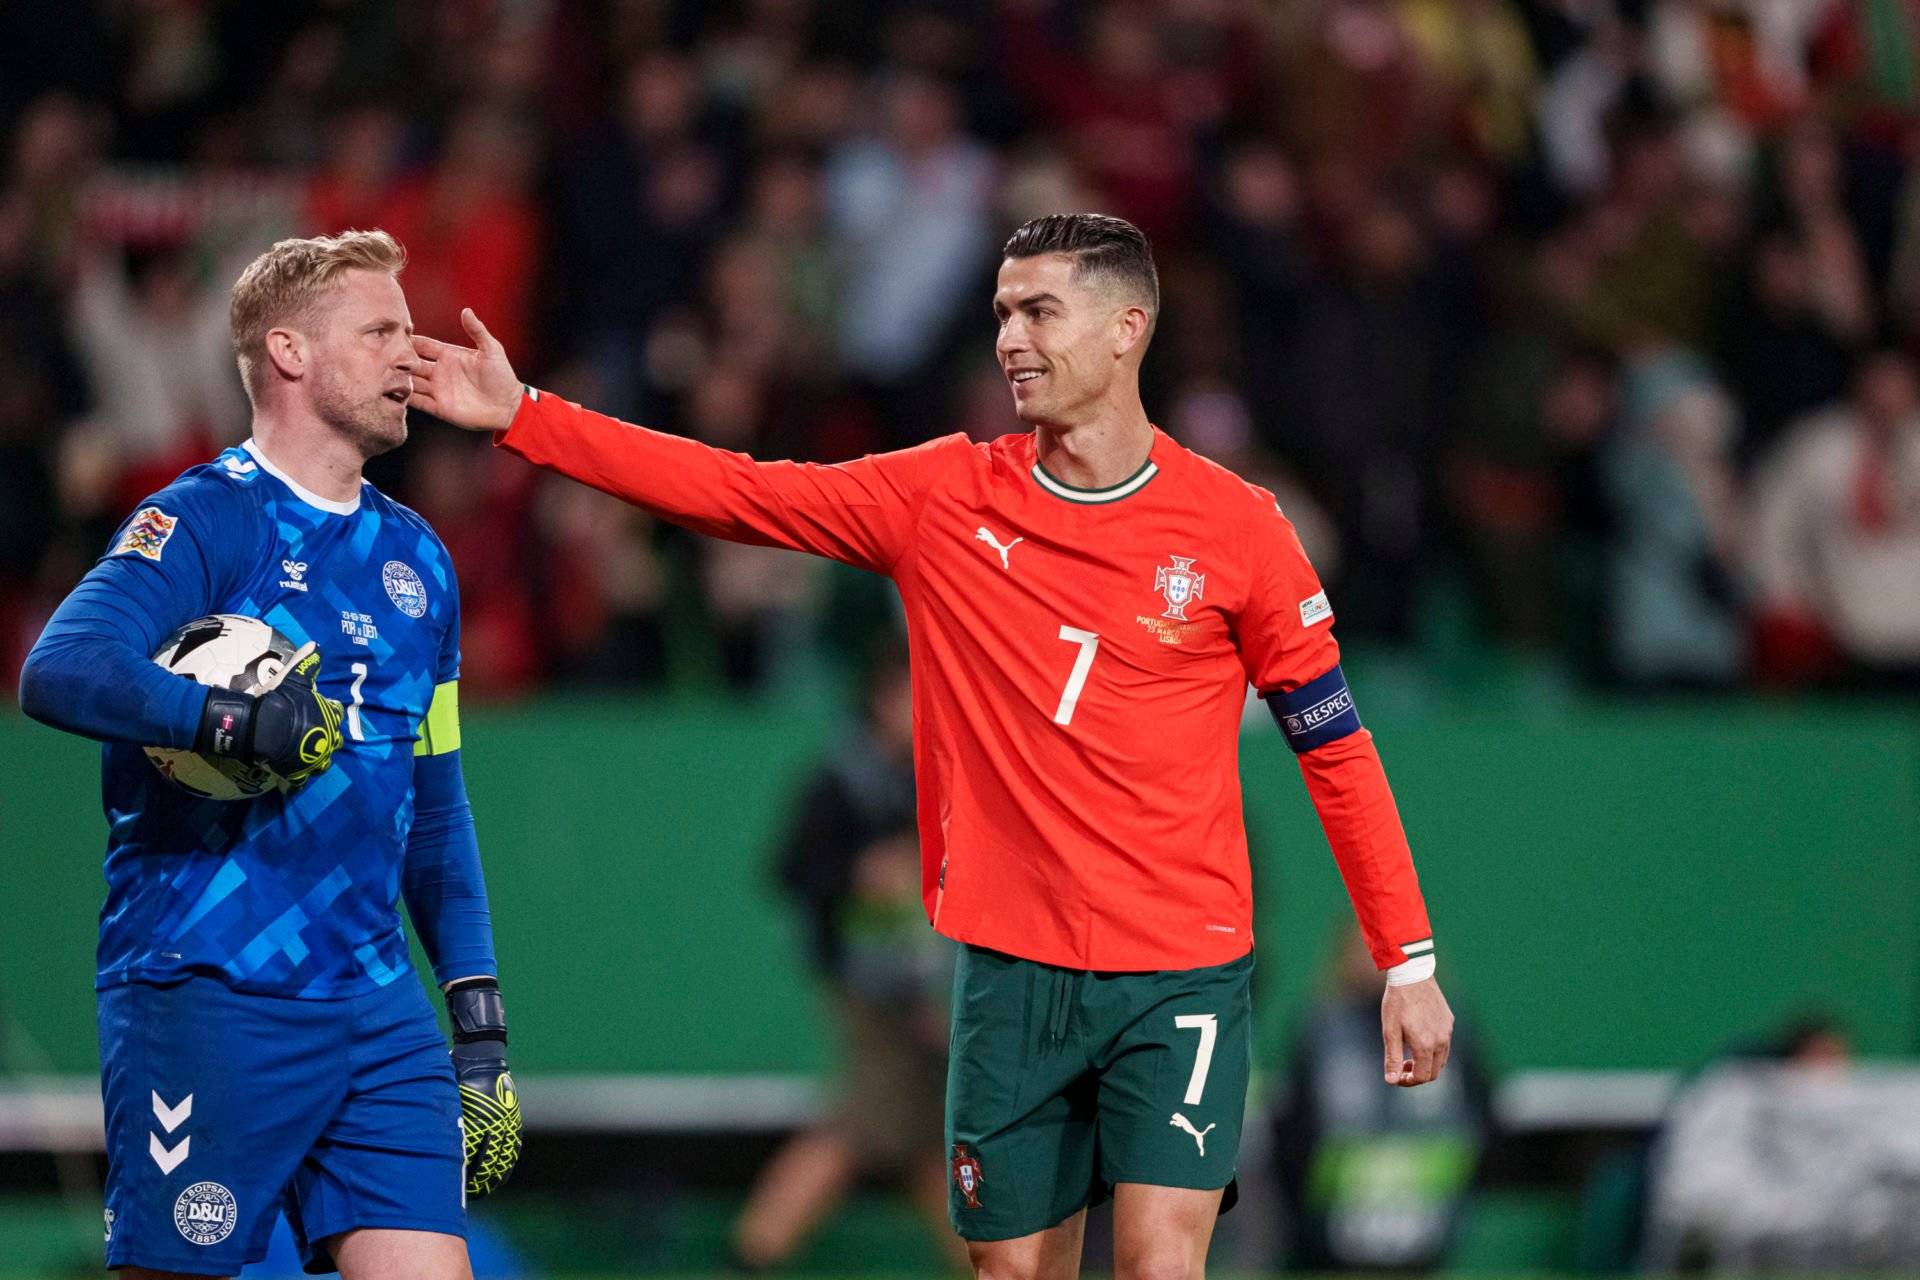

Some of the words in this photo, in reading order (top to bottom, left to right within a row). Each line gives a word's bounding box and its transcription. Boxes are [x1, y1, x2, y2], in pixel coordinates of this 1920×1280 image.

[391, 579, 419, 597] DBU
[341, 619, 356, 636] POR
[1053, 624, 1101, 727] 7
[1303, 691, 1351, 726] RESPECT
[1174, 1013, 1218, 1106] 7
[187, 1202, 226, 1223] DBU
[191, 1232, 218, 1243] 1889
